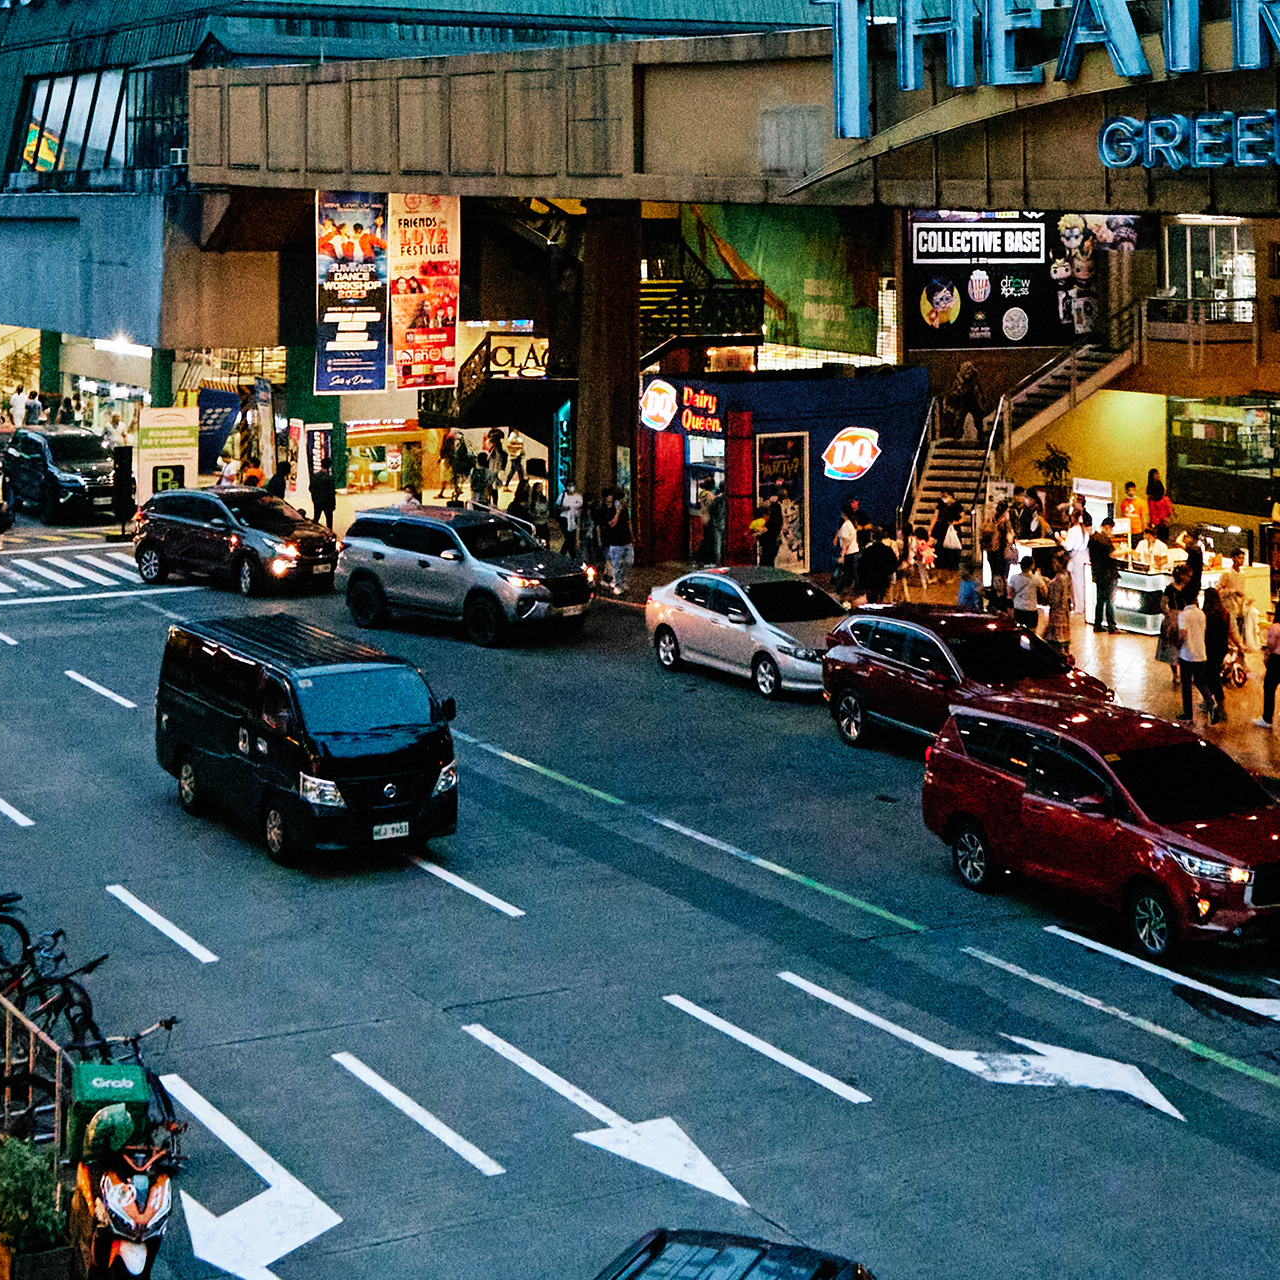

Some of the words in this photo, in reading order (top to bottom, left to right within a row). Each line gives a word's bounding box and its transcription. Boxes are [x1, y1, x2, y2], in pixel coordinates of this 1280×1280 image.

[398, 216, 438, 229] FRIENDS
[400, 228, 448, 246] LOVE
[918, 230, 1002, 253] COLLECTIVE
[1004, 230, 1040, 253] BASE
[328, 263, 377, 273] SUMMER
[334, 272, 370, 281] DANCE
[323, 281, 382, 291] WORKSHOP
[337, 290, 367, 299] 2023
[645, 390, 672, 418] DQ
[682, 385, 718, 414] Dairy
[832, 440, 872, 467] DQ
[91, 1077, 135, 1089] Grab
